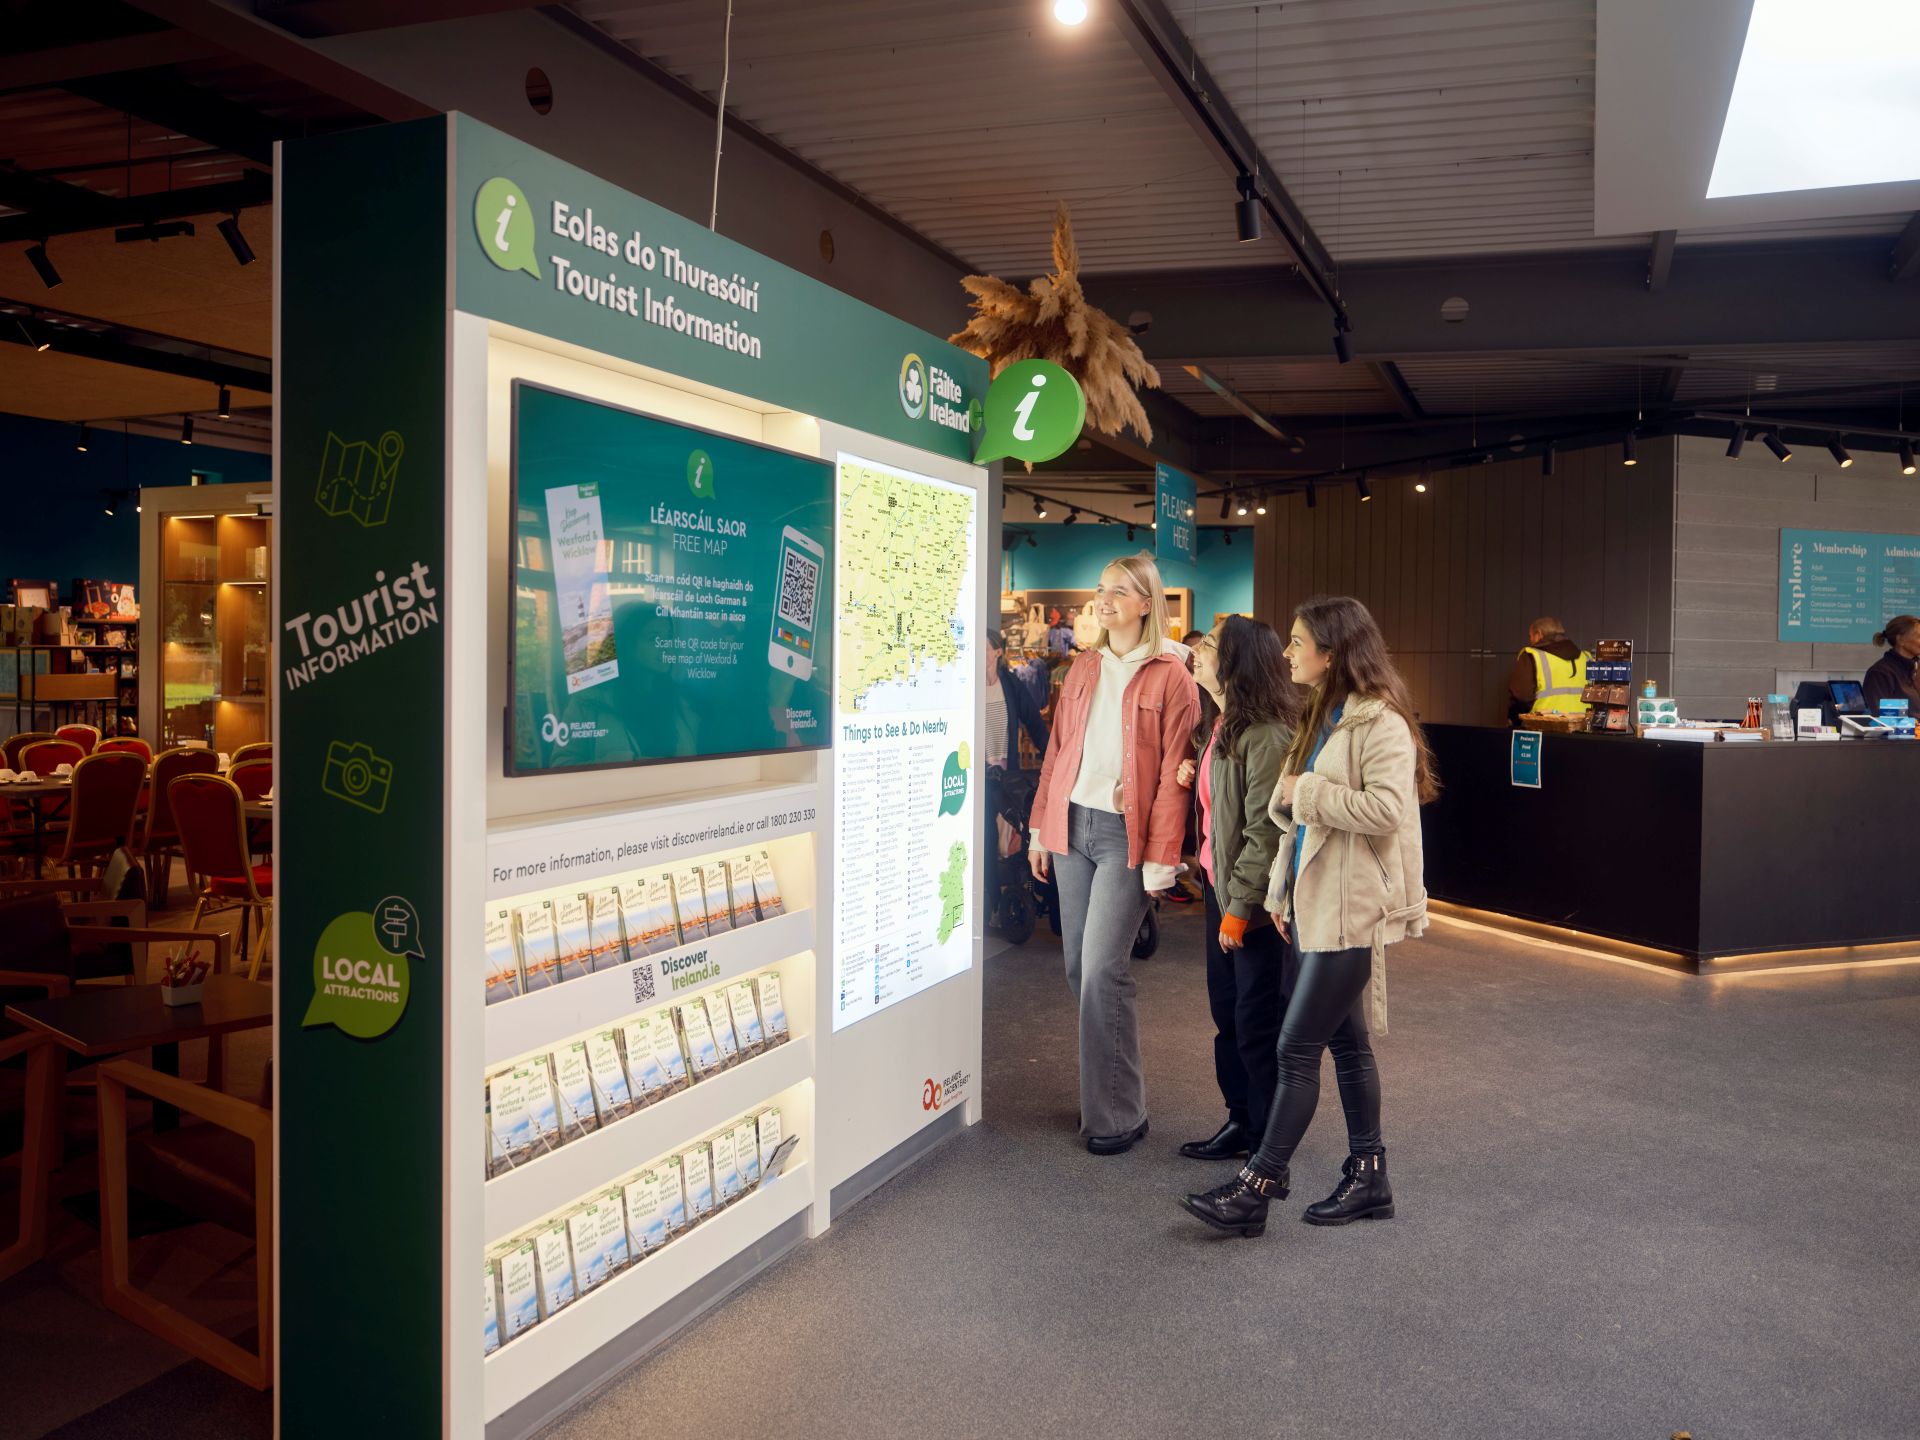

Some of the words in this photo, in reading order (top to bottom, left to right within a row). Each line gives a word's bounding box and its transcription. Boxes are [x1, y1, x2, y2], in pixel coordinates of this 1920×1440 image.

[552, 200, 619, 257] Eolas
[625, 231, 656, 270] do
[659, 245, 759, 313] Thurasóirí
[551, 255, 638, 317] Tourist
[644, 287, 761, 359] Information
[929, 394, 970, 433] Ireland
[650, 502, 714, 533] LÉARSCÁIL
[716, 518, 747, 538] SAOR
[673, 533, 700, 553] FREE
[704, 538, 728, 556] MAP
[1173, 524, 1190, 551] HERE
[1813, 543, 1868, 558] Membership
[645, 571, 663, 583] Scan
[665, 575, 675, 583] an
[676, 573, 691, 585] cód
[692, 576, 703, 589] QR
[704, 576, 712, 587] le
[712, 577, 743, 591] haghaidh
[744, 581, 754, 592] do
[1788, 543, 1806, 626] Explore
[285, 560, 437, 658] Tourist
[685, 591, 695, 603] de
[696, 592, 713, 604] Loch
[714, 595, 741, 606] Garman
[742, 597, 747, 607] &
[655, 605, 669, 617] Cill
[670, 606, 703, 619] Mhantáin
[705, 611, 720, 621] saor
[721, 609, 728, 621] in
[729, 610, 746, 622] aisce
[285, 601, 439, 691] INFORMATION
[655, 636, 673, 648] Scan
[674, 637, 687, 649] the
[688, 638, 699, 652] QR
[700, 638, 718, 650] code
[719, 638, 729, 650] for
[729, 641, 745, 652] your
[662, 651, 676, 664] free
[678, 654, 694, 666] map
[695, 652, 703, 664] of
[703, 652, 732, 664] Wexford
[732, 654, 738, 664] &
[687, 668, 717, 679] Wicklow
[785, 707, 812, 719] Discover
[790, 717, 817, 729] Ireland.ie
[843, 723, 872, 744] Things
[874, 723, 883, 739] to
[885, 722, 900, 738] See
[901, 721, 908, 736] &
[909, 720, 921, 735] Do
[922, 718, 948, 735] Nearby
[943, 774, 965, 790] LOCAL
[493, 867, 512, 883] For
[516, 862, 547, 879] more
[550, 847, 614, 872] information,
[617, 841, 648, 862] please
[650, 831, 669, 851] visit
[671, 821, 744, 847] discoverireland.ie
[746, 821, 755, 832] or
[756, 815, 769, 830] call
[771, 812, 788, 827] 1800
[789, 810, 802, 824] 230
[803, 808, 816, 821] 330
[322, 956, 401, 988] LOCAL
[661, 949, 708, 976] Discover
[671, 961, 721, 991] Ireland.ie
[324, 983, 400, 1004] ATTRACTIONS
